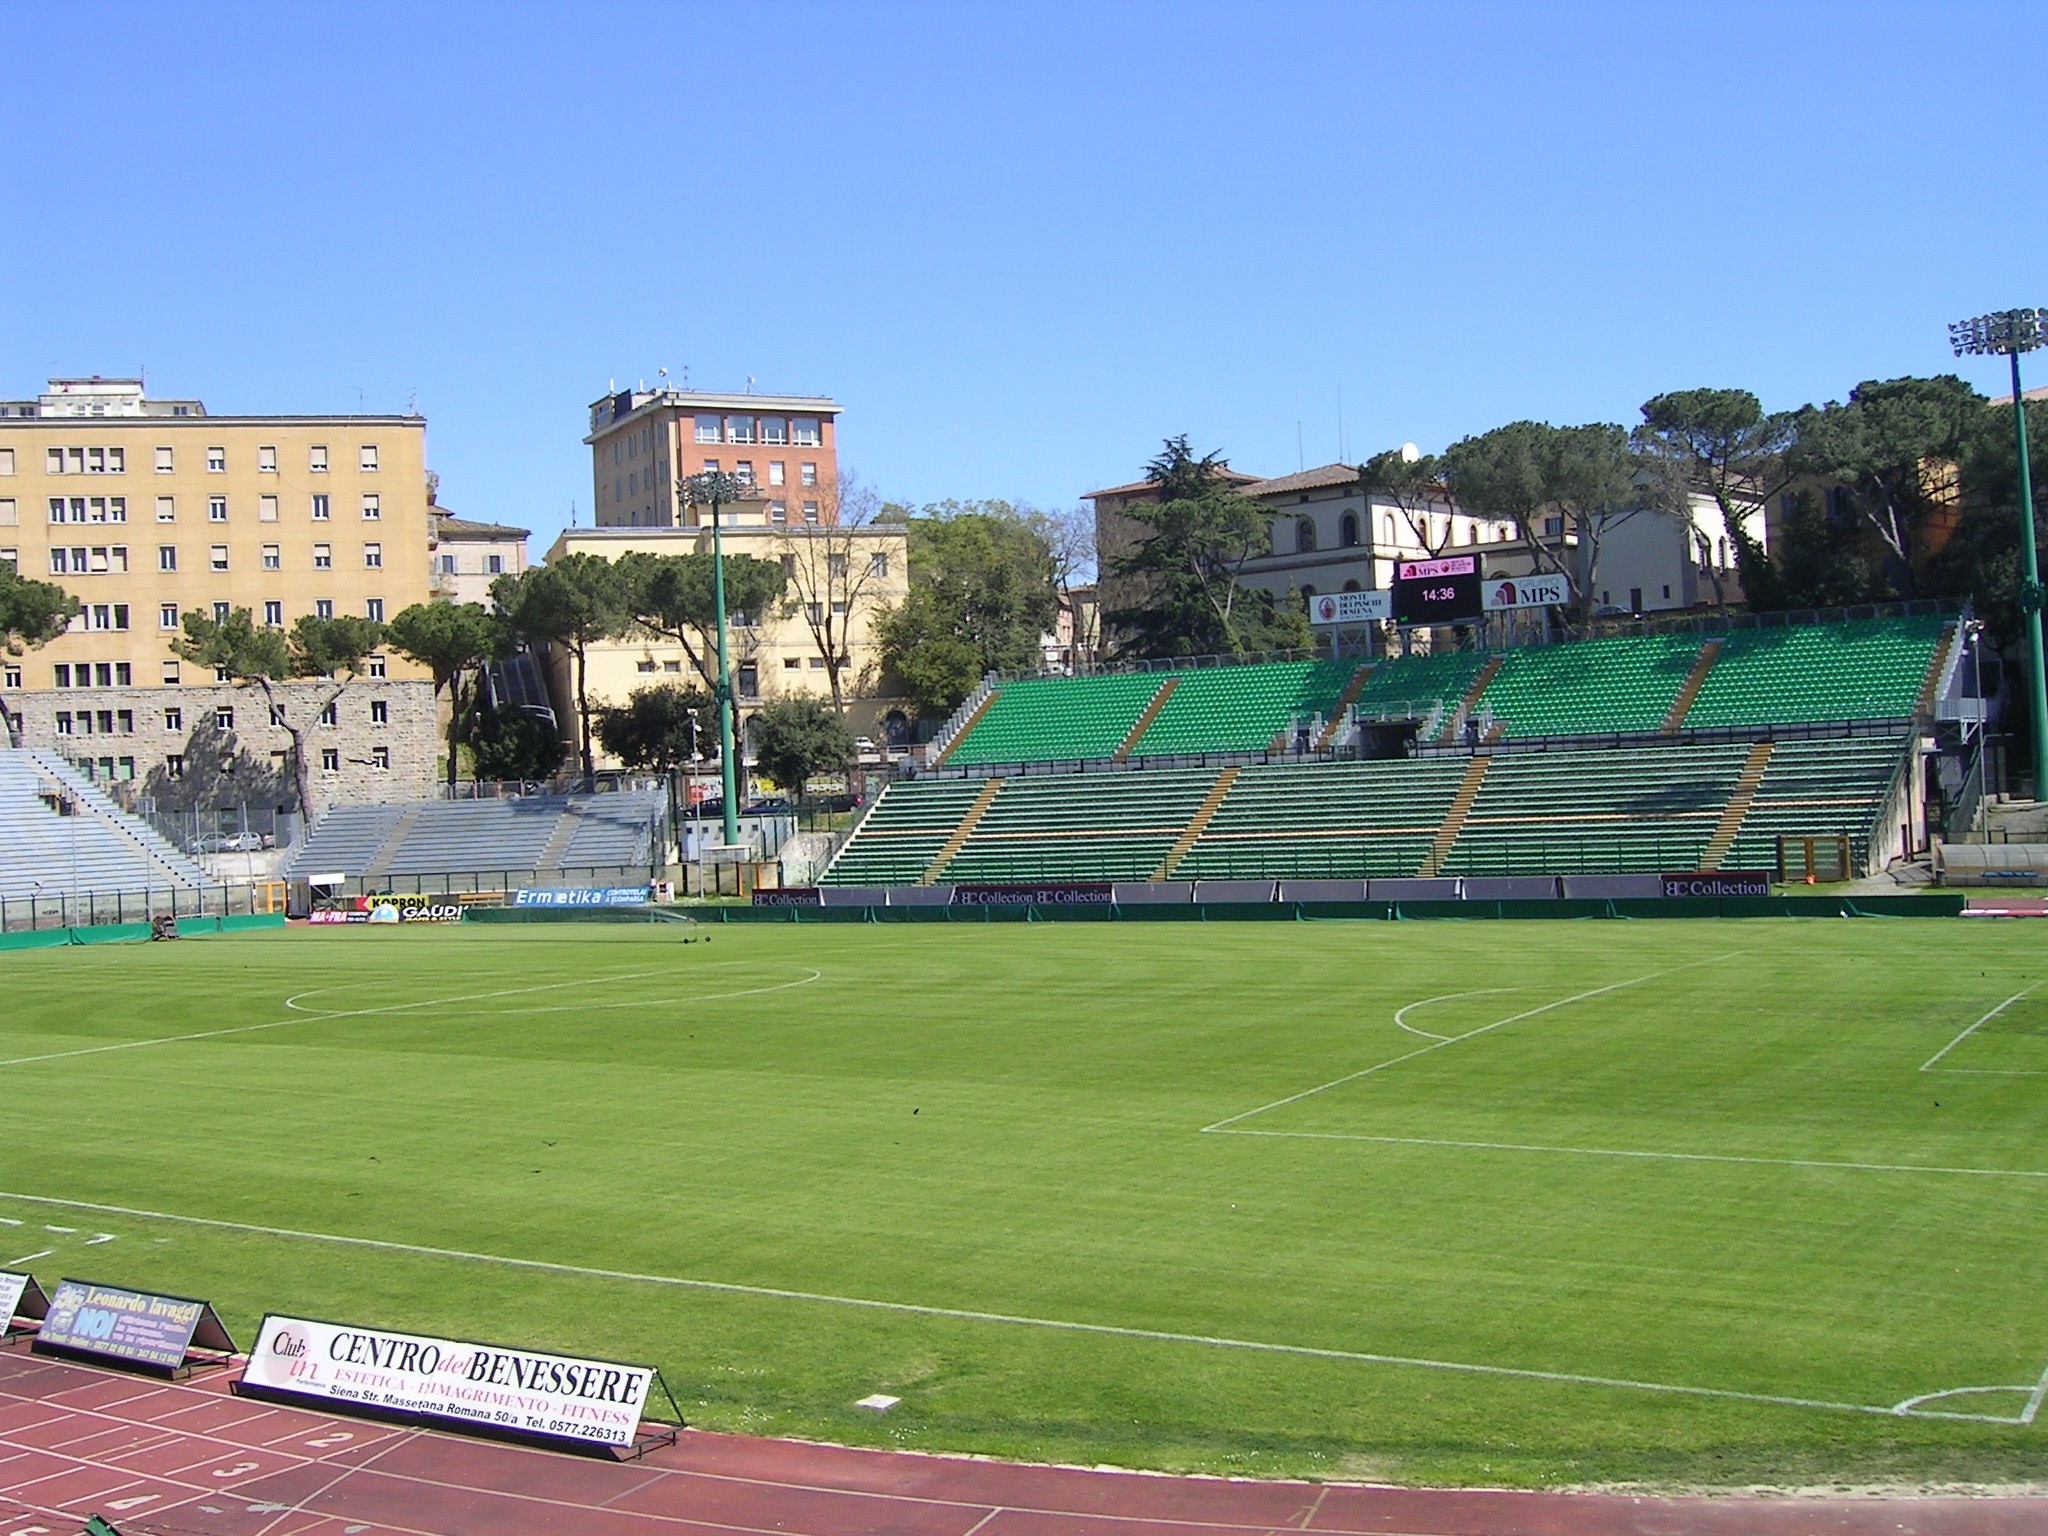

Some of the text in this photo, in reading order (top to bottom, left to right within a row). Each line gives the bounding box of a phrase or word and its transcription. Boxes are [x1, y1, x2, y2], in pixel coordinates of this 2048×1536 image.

[1519, 577, 1559, 588] GRUPPO
[1422, 587, 1455, 601] 14:36
[1521, 586, 1560, 604] MPS
[1690, 881, 1766, 895] Collection
[372, 897, 425, 908] KOPRON
[769, 894, 818, 905] Collection
[979, 891, 1033, 904] Collection
[1054, 890, 1111, 904] Collection
[85, 1286, 146, 1314] Leonardo
[72, 1307, 119, 1340] NOI
[272, 1331, 306, 1358] Club
[289, 1359, 319, 1380] in
[329, 1332, 643, 1405] CENTRO del BENESSERE
[334, 1368, 631, 1425] ESTETICA DIMAGRIMENTO FITNESS
[329, 1384, 359, 1400] Siena
[361, 1390, 379, 1402] Str.
[383, 1394, 444, 1412] Massetana
[446, 1403, 491, 1419] Romana
[526, 1416, 545, 1429] Tel.
[549, 1420, 627, 1443] 0577.226313
[304, 1432, 354, 1448] 2
[212, 1462, 260, 1477] 3
[104, 1494, 162, 1510] 4
